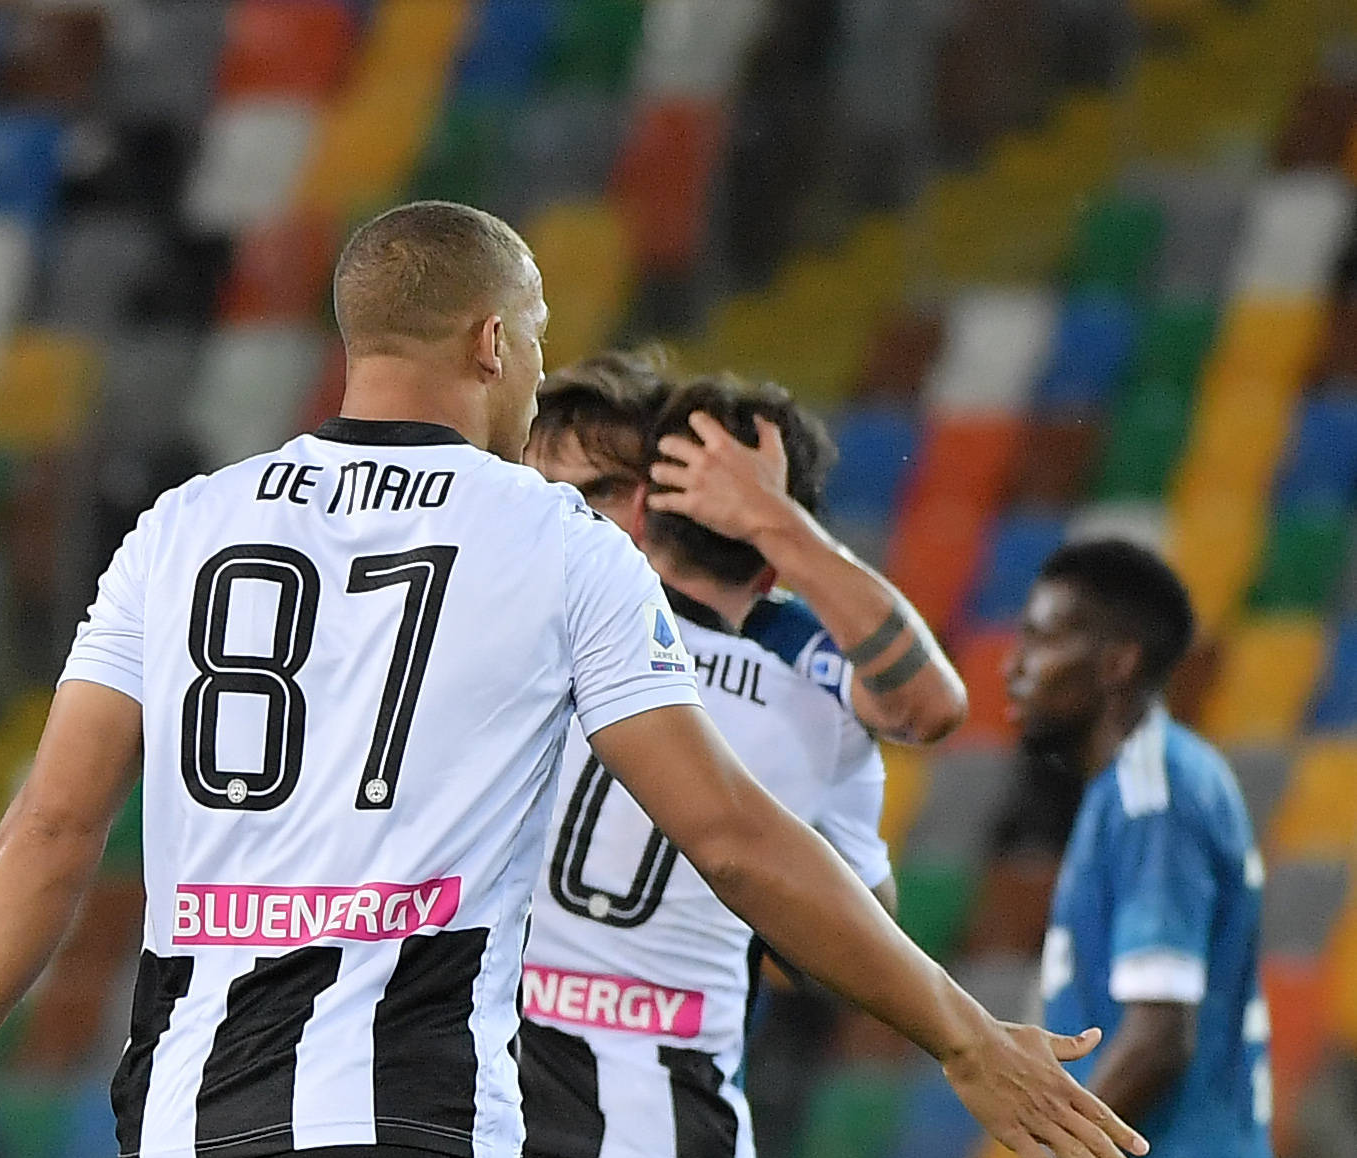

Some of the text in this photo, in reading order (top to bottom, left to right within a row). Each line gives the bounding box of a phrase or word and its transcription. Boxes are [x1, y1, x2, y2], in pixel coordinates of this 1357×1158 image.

[255, 460, 456, 516] DE MAIO
[180, 544, 459, 811] 87
[173, 886, 442, 938] BLUENERGY
[523, 968, 686, 1032] NERGY
